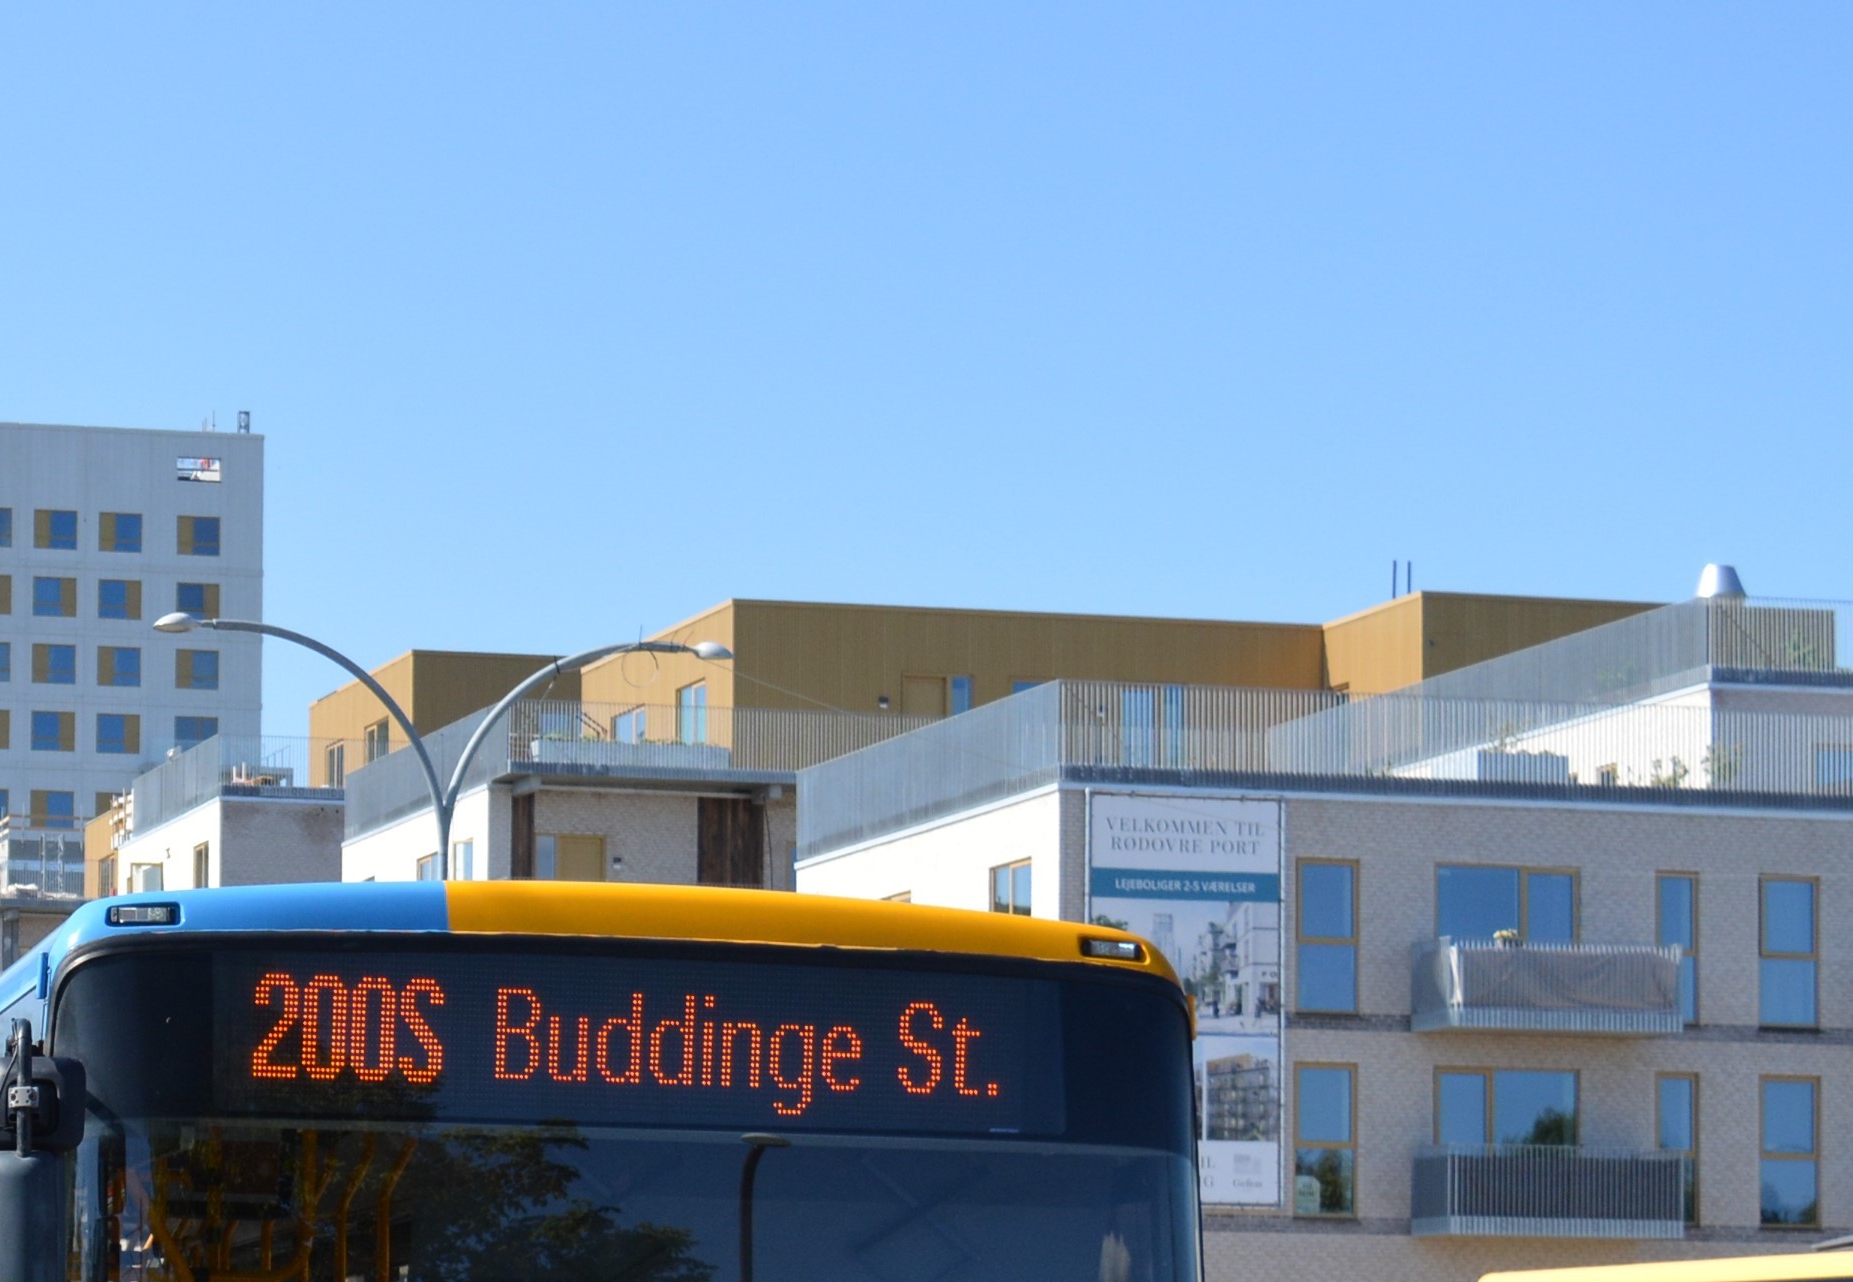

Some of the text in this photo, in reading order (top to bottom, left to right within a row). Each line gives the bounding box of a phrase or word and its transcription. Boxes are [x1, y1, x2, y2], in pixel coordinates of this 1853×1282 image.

[1106, 815, 1265, 837] VELKOMMEN TIL
[1210, 838, 1261, 855] PORT
[1114, 877, 1182, 892] LEJEBOLIGER
[1202, 881, 1257, 893] VÆRELSER
[251, 973, 1001, 1116] 200S Buddinge St.
